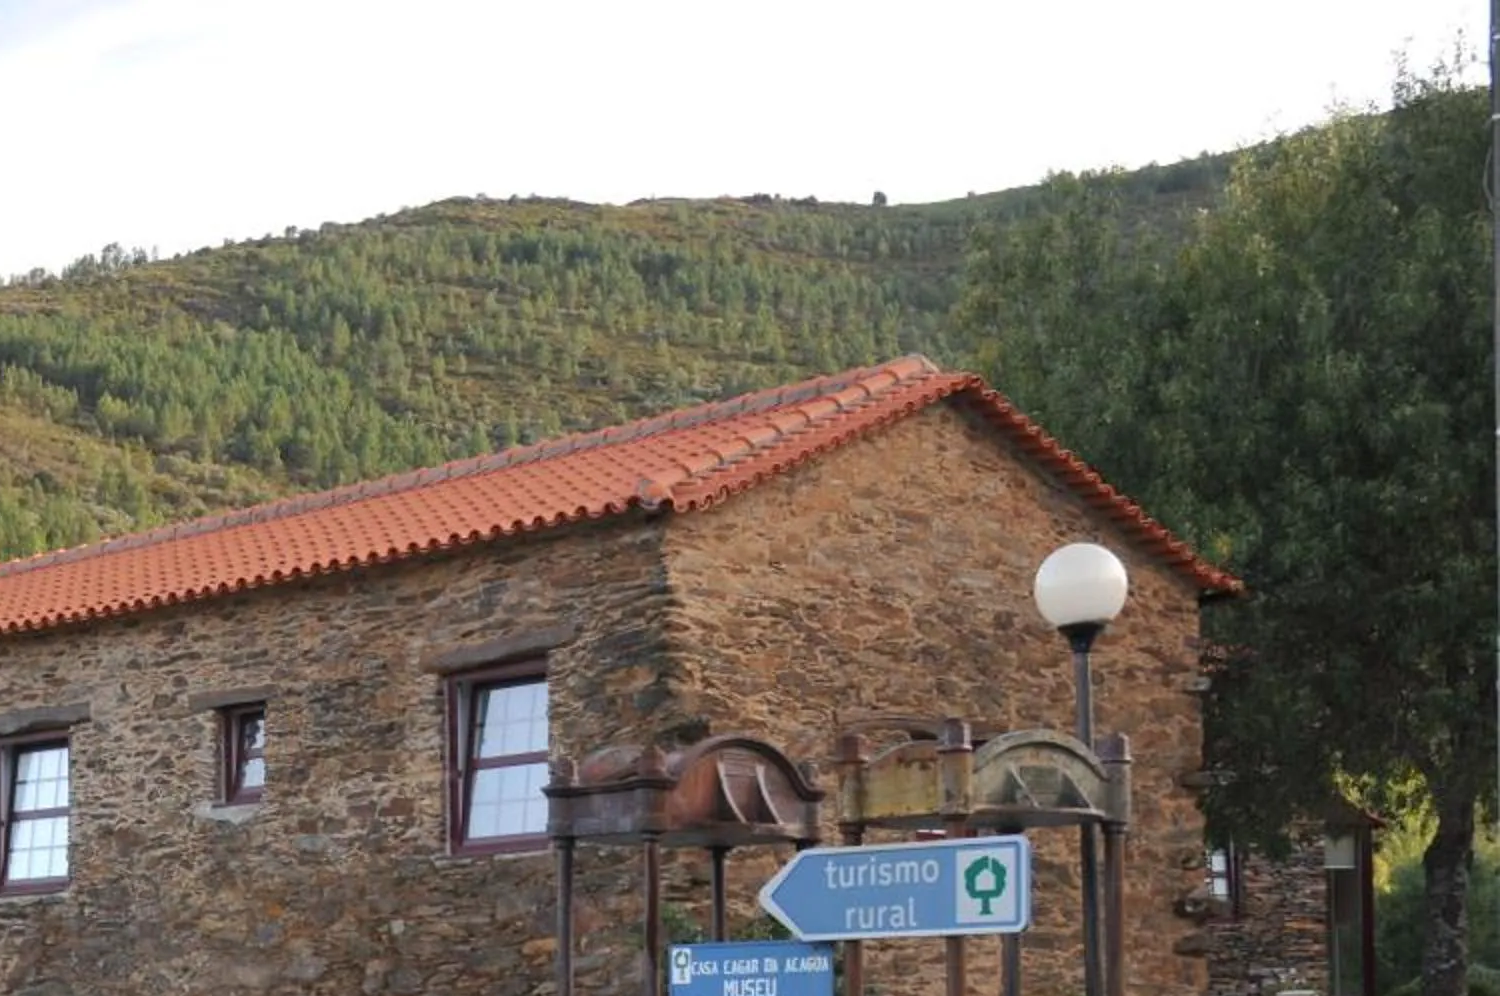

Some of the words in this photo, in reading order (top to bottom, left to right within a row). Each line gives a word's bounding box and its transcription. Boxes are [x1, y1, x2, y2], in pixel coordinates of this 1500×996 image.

[824, 857, 940, 889] turismo
[845, 898, 917, 929] rural
[691, 961, 719, 976] CASA
